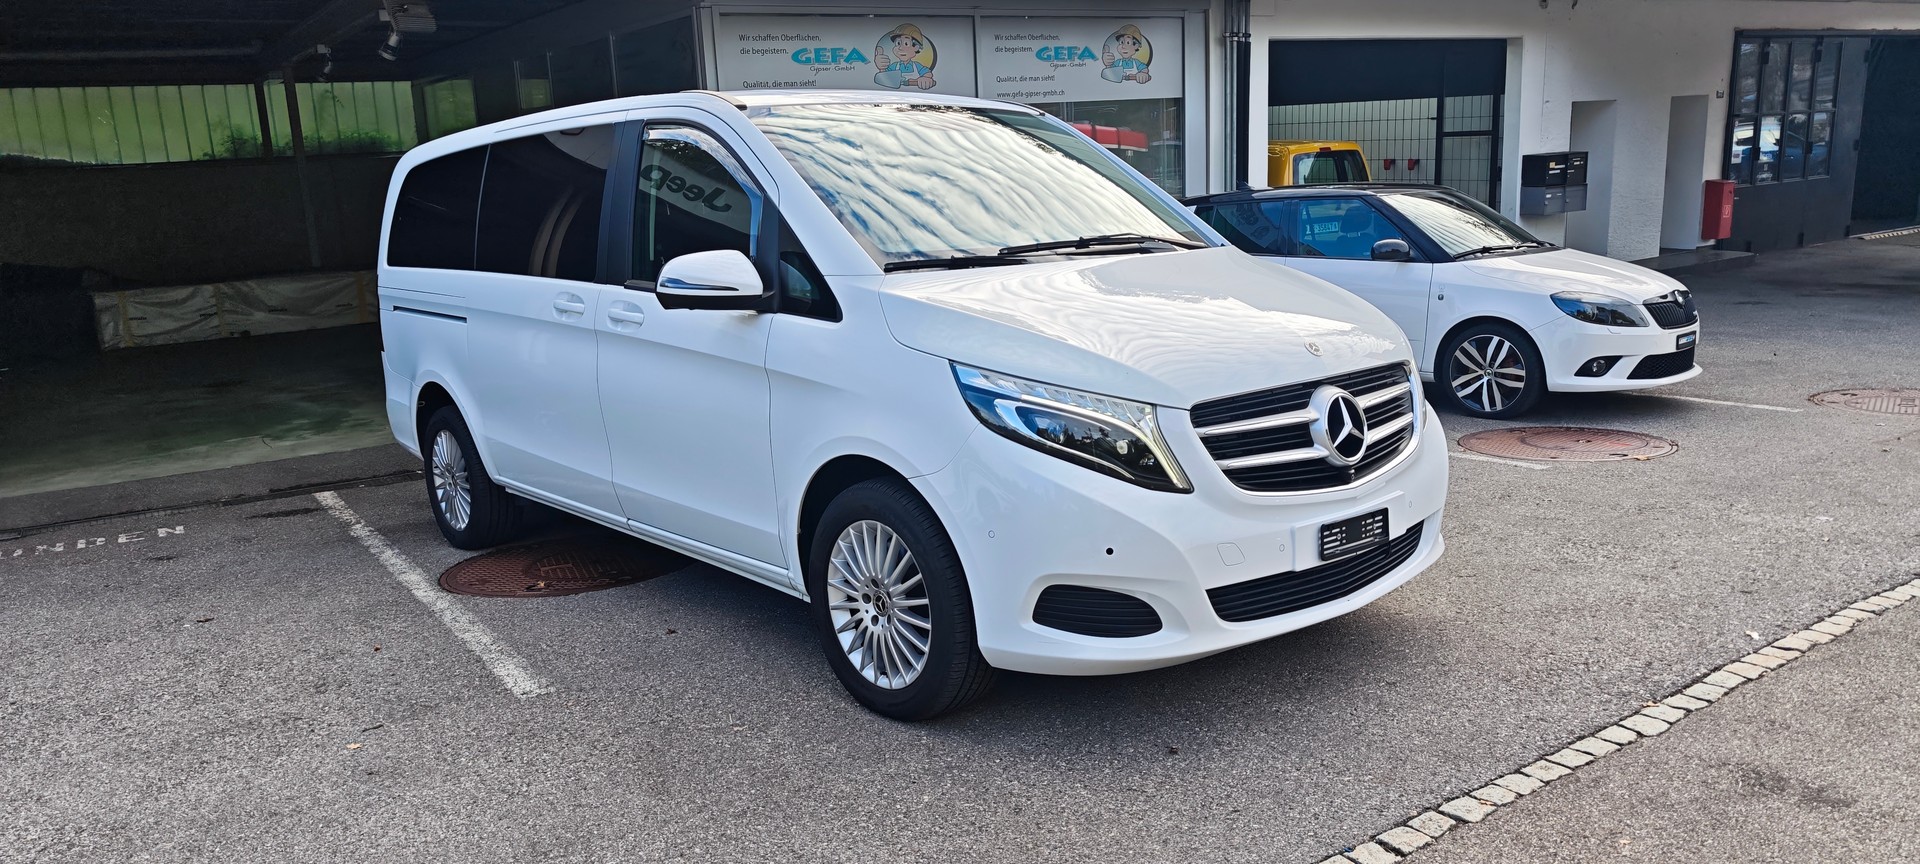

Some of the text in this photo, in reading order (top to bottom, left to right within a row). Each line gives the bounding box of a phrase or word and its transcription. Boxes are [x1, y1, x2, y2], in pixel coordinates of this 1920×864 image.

[752, 33, 780, 41] schaffen
[781, 33, 821, 42] Oberflächen,
[740, 47, 789, 56] die begeistern.
[1004, 46, 1034, 54] begeistern.
[1035, 46, 1099, 62] GEFA
[791, 47, 871, 65] GEFA
[742, 79, 817, 89] Qualität, die man sieht!
[996, 89, 1066, 99] www.gefa-gipser-gmbh.ch
